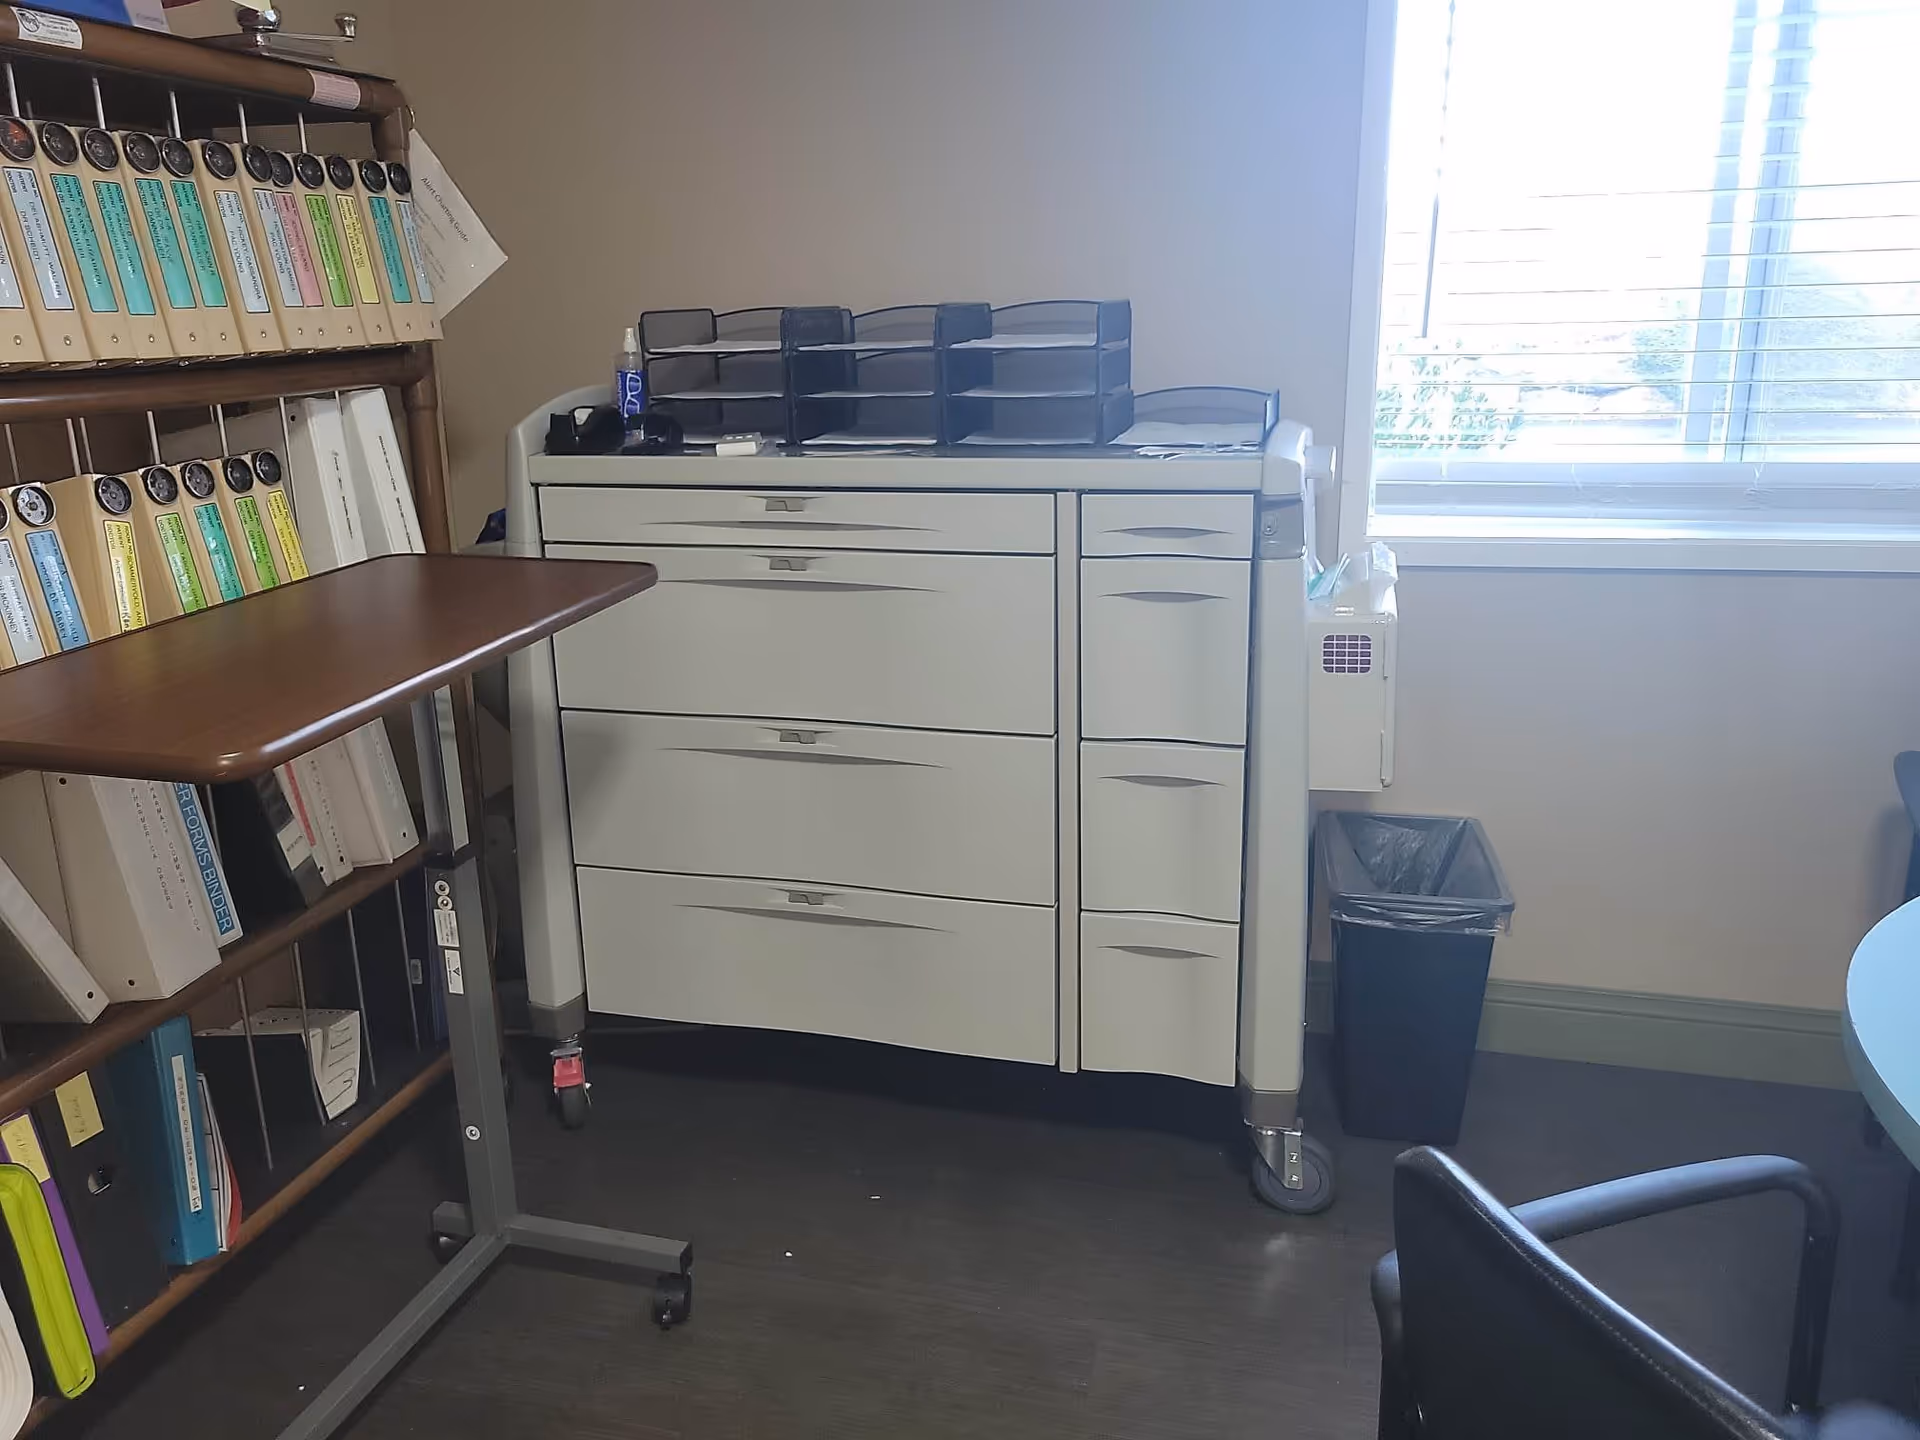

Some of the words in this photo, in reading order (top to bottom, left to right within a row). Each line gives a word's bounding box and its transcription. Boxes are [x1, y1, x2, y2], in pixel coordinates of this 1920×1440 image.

[421, 177, 436, 198] Alert
[434, 194, 455, 225] Charting
[454, 221, 469, 243] Guide
[183, 805, 212, 866] FORMS
[203, 868, 232, 932] BINDER
